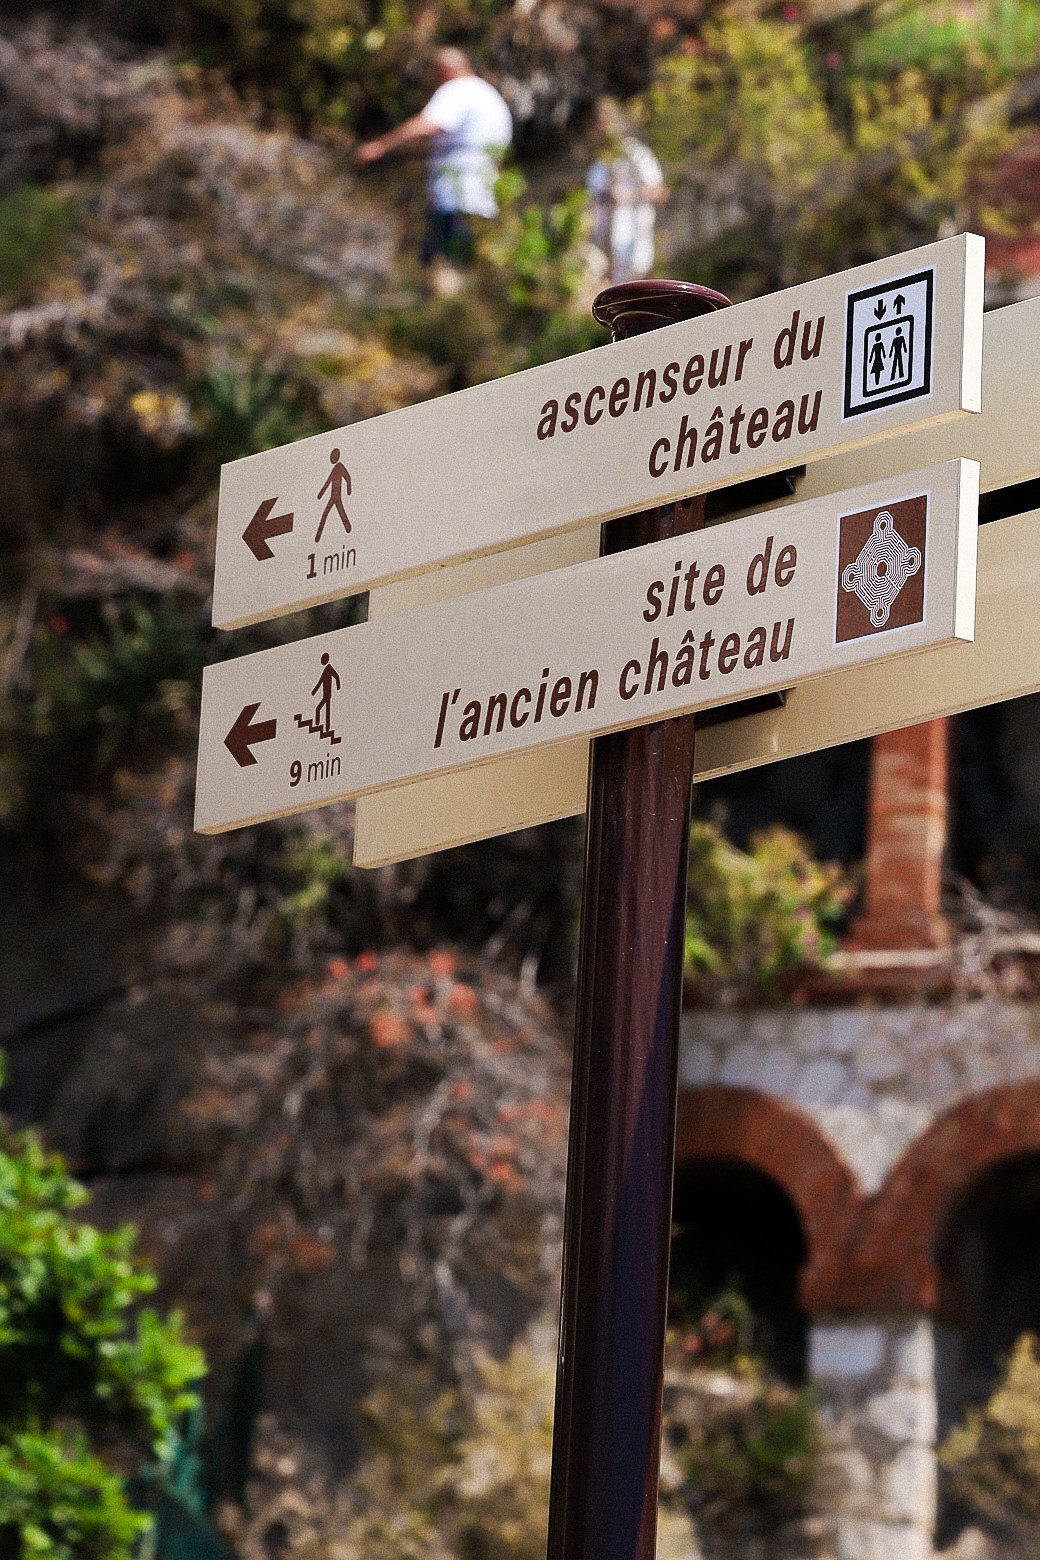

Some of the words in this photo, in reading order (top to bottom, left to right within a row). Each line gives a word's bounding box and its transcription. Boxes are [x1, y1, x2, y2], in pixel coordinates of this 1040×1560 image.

[536, 337, 754, 441] ascenseur
[773, 309, 826, 370] du
[648, 389, 823, 479] château
[306, 553, 318, 580] 1
[323, 544, 357, 576] min
[642, 560, 726, 623] site
[746, 535, 798, 597] de
[433, 667, 599, 749] l'ancien
[618, 617, 796, 702] château
[289, 759, 303, 788] 9
[307, 752, 341, 783] min
